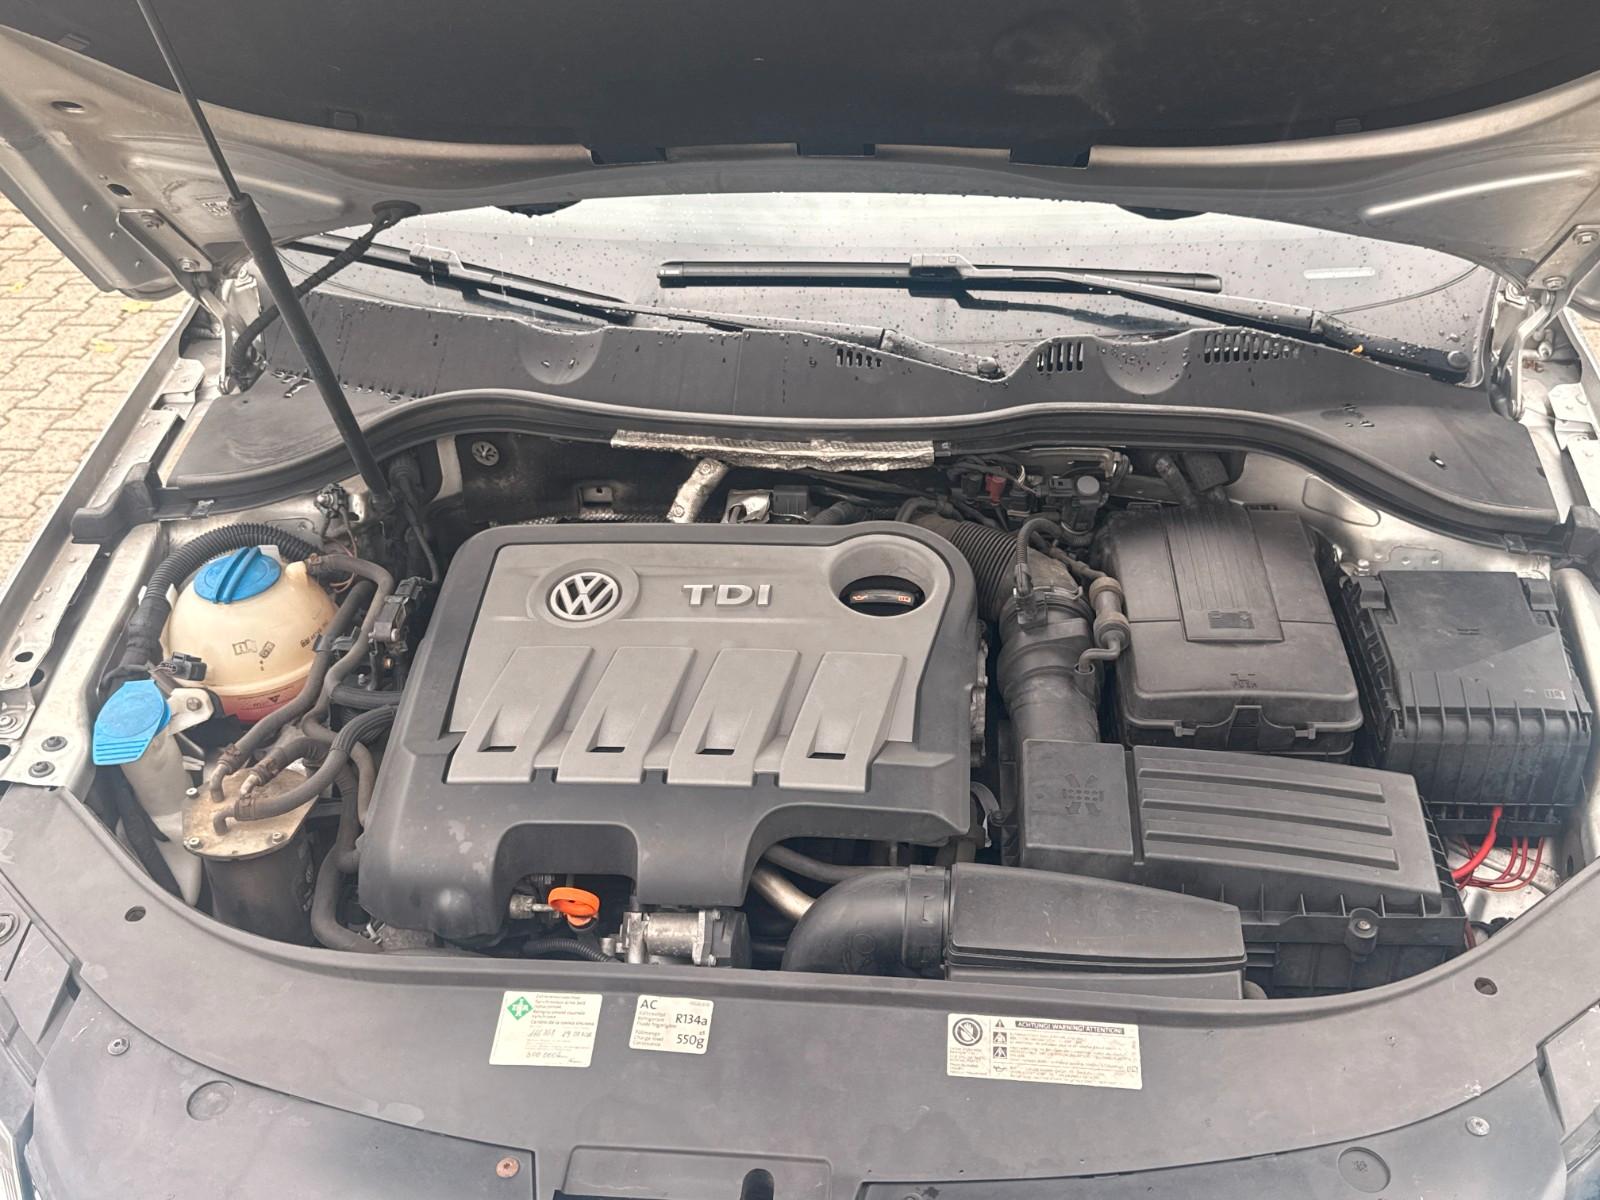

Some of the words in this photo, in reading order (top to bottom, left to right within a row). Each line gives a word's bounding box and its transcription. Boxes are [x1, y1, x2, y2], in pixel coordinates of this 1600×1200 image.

[682, 584, 772, 606] TDI
[640, 999, 658, 1010] AC
[675, 1013, 708, 1026] R134a
[1017, 1021, 1050, 1030] ACHTUNG!
[1052, 1023, 1085, 1032] WARNING!
[676, 1034, 705, 1049] 550g
